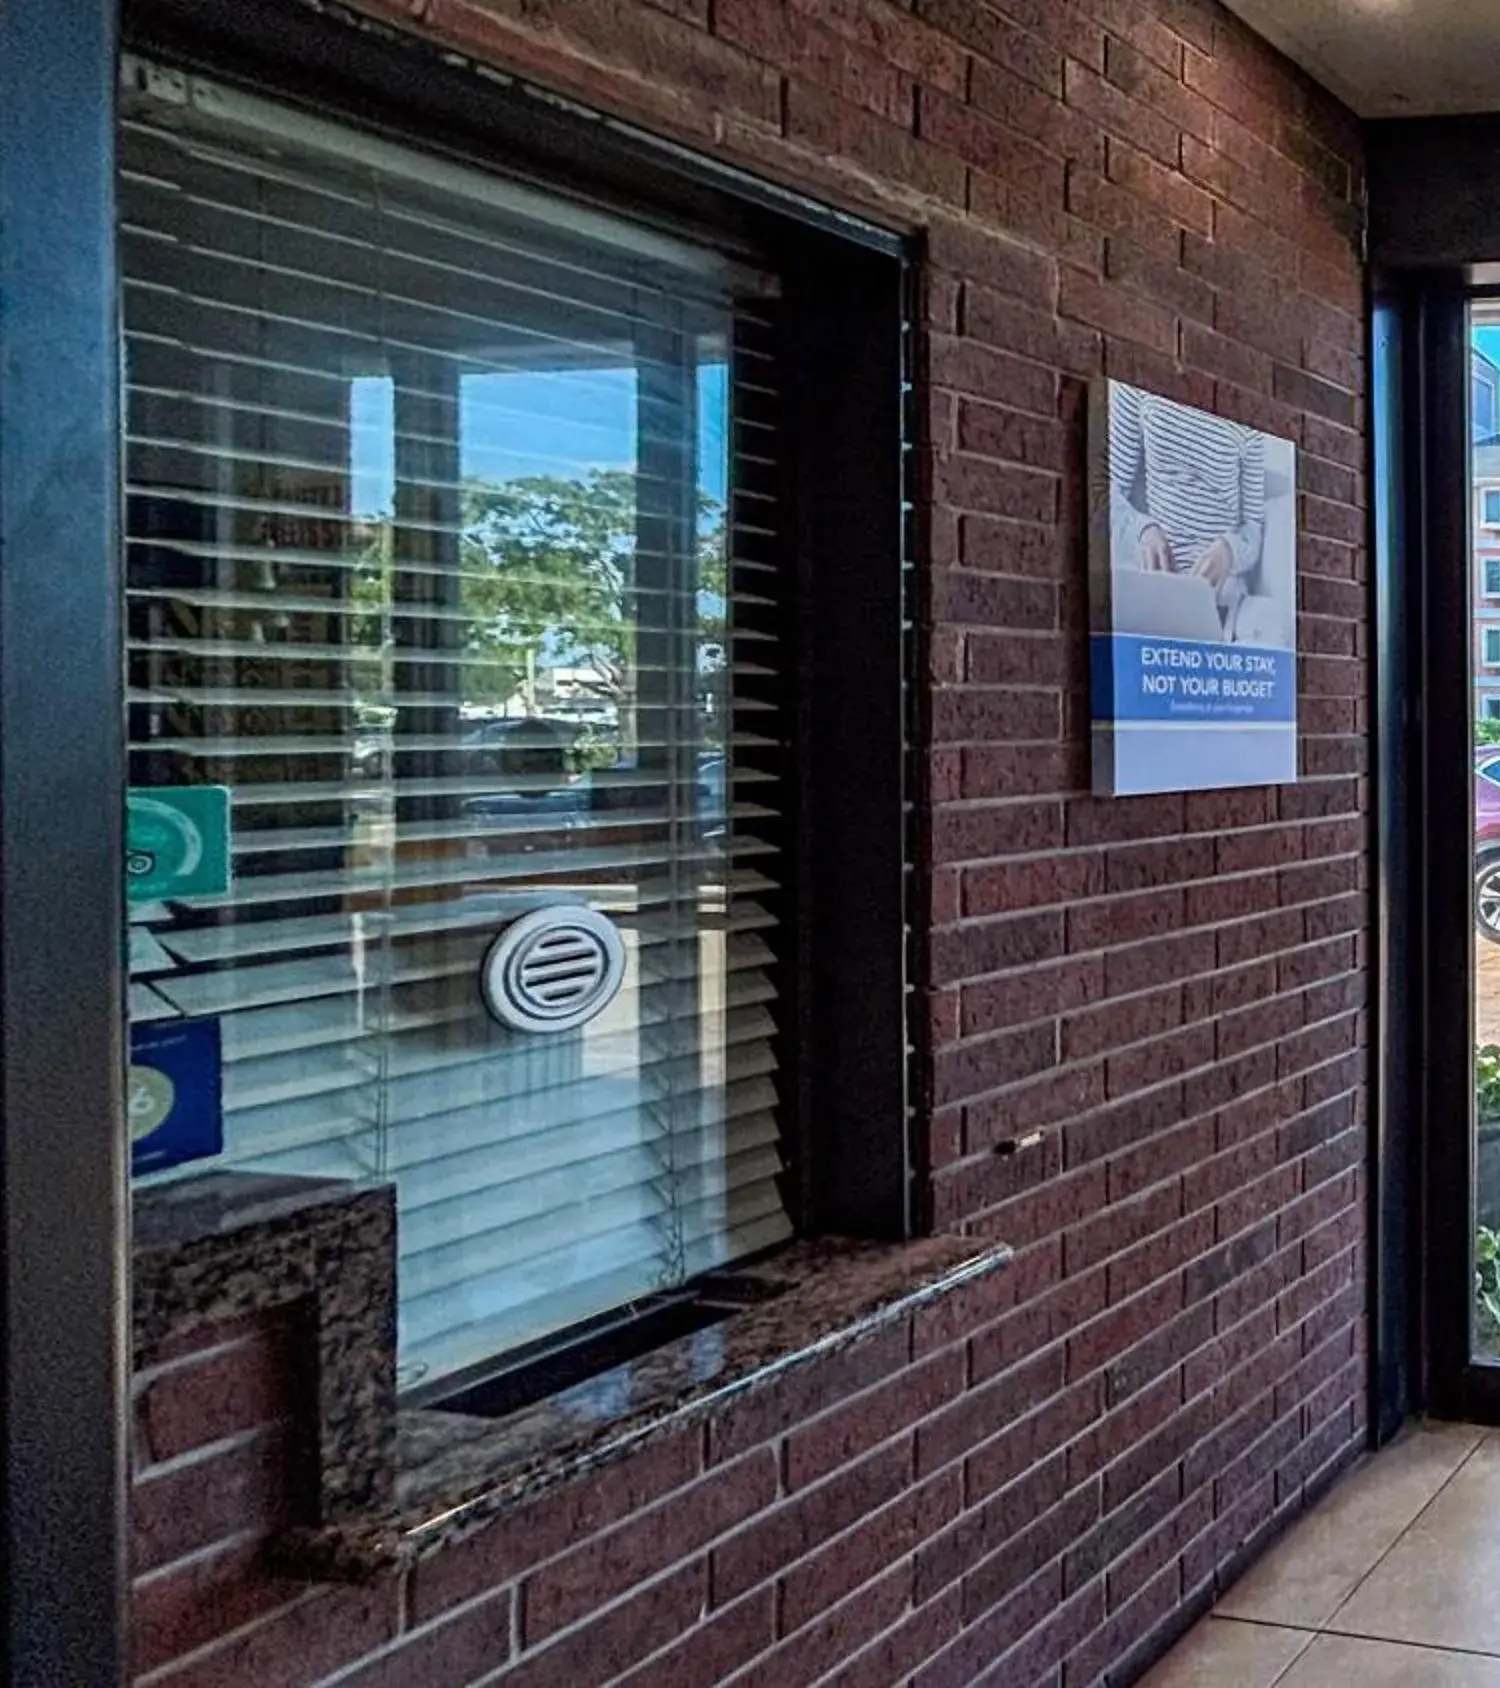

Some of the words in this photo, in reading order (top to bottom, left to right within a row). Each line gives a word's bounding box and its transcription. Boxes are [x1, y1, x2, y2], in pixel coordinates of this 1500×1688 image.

[1141, 647, 1201, 668] EXTEND
[1205, 652, 1242, 672] YOUR
[1245, 656, 1276, 676] STAY,
[1143, 675, 1176, 694] NOT
[1181, 678, 1219, 696] YOUR
[1222, 680, 1276, 697] BUDGET
